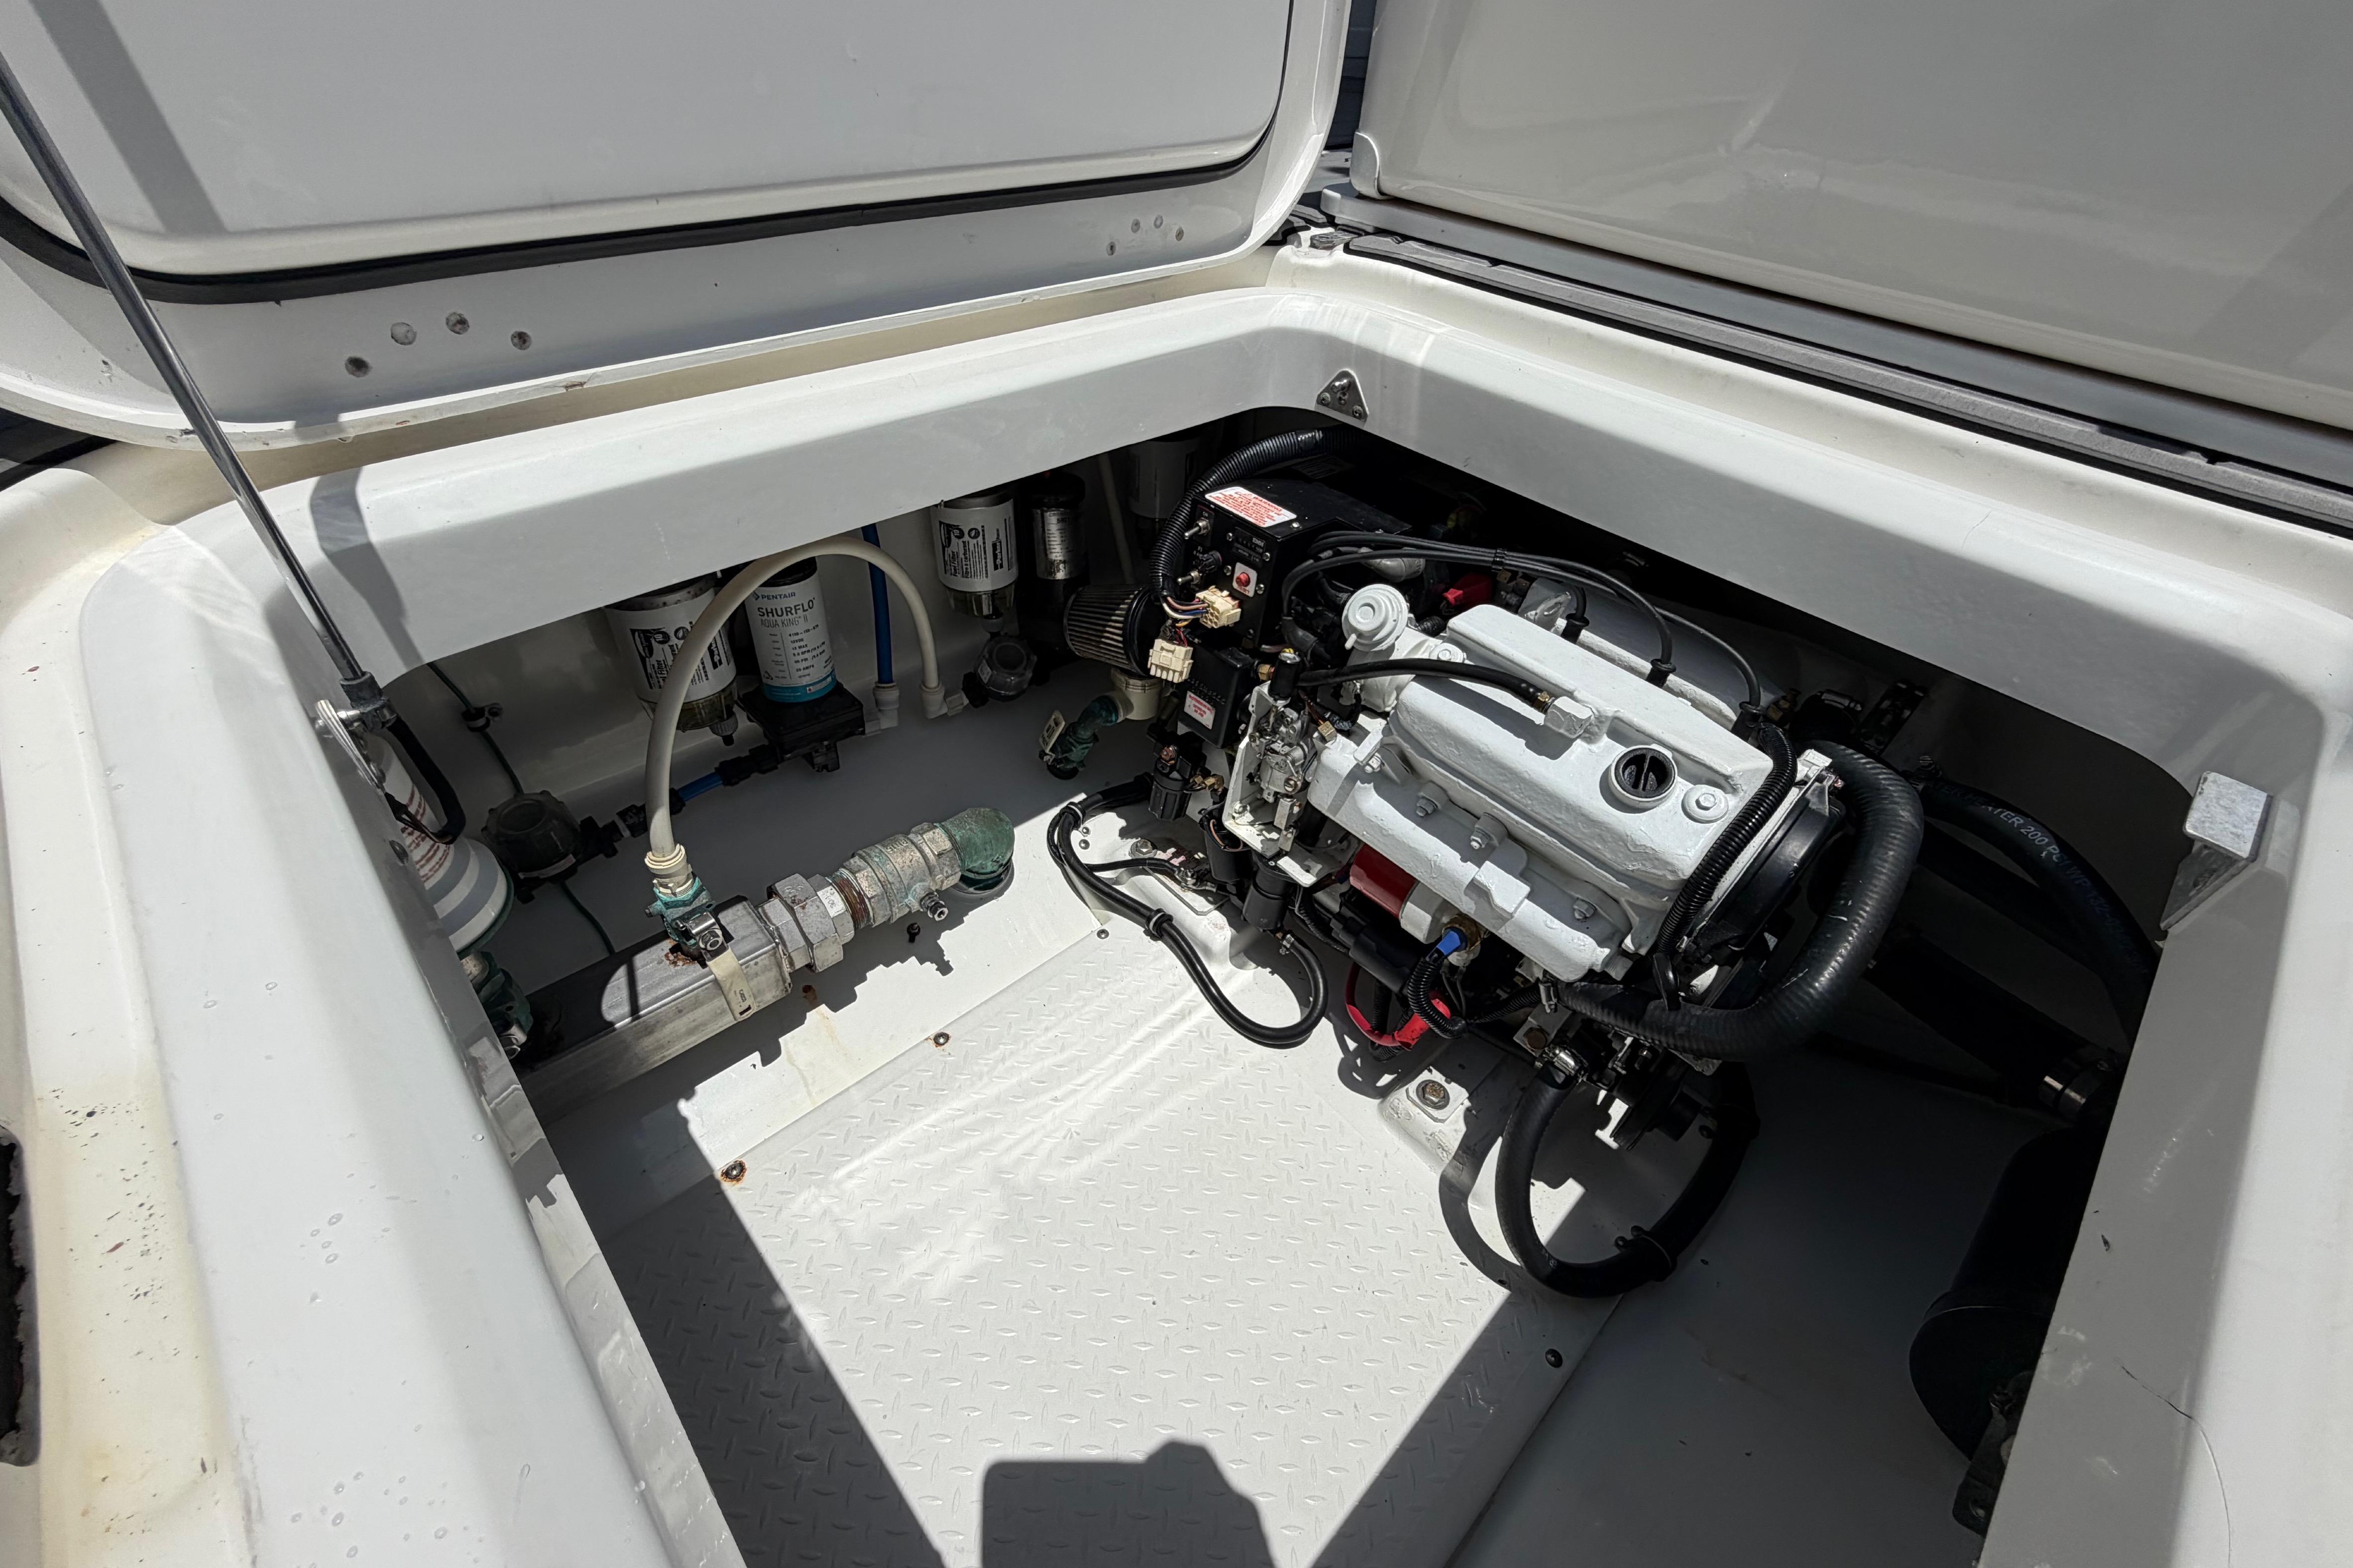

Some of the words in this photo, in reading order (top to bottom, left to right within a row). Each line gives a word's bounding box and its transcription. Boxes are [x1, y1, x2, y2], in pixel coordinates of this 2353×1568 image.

[761, 618, 780, 628] AQUA
[656, 659, 666, 675] Filter
[2019, 825, 2049, 845] 200
